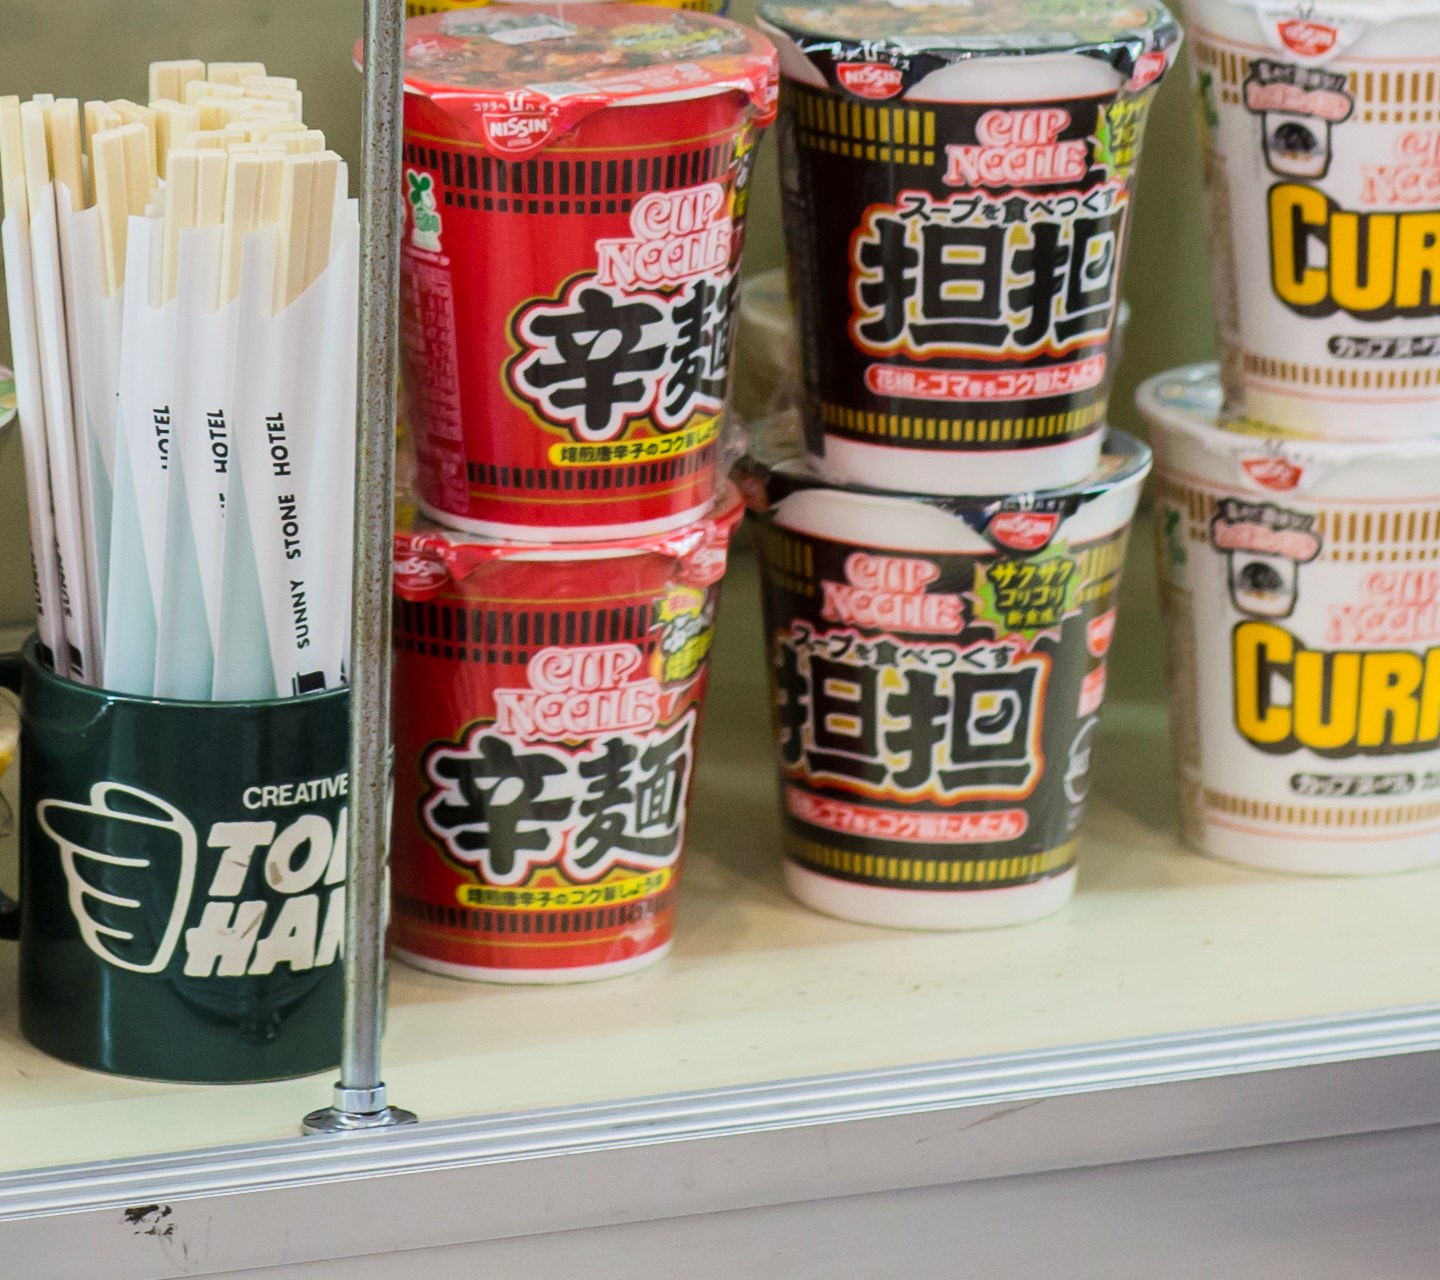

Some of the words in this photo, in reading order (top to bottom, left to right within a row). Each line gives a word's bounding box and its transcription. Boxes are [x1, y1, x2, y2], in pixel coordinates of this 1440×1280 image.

[488, 118, 552, 139] NISSIN
[264, 411, 292, 477] HOTEL
[277, 492, 302, 561] STONE
[289, 579, 311, 650] SUNNY
